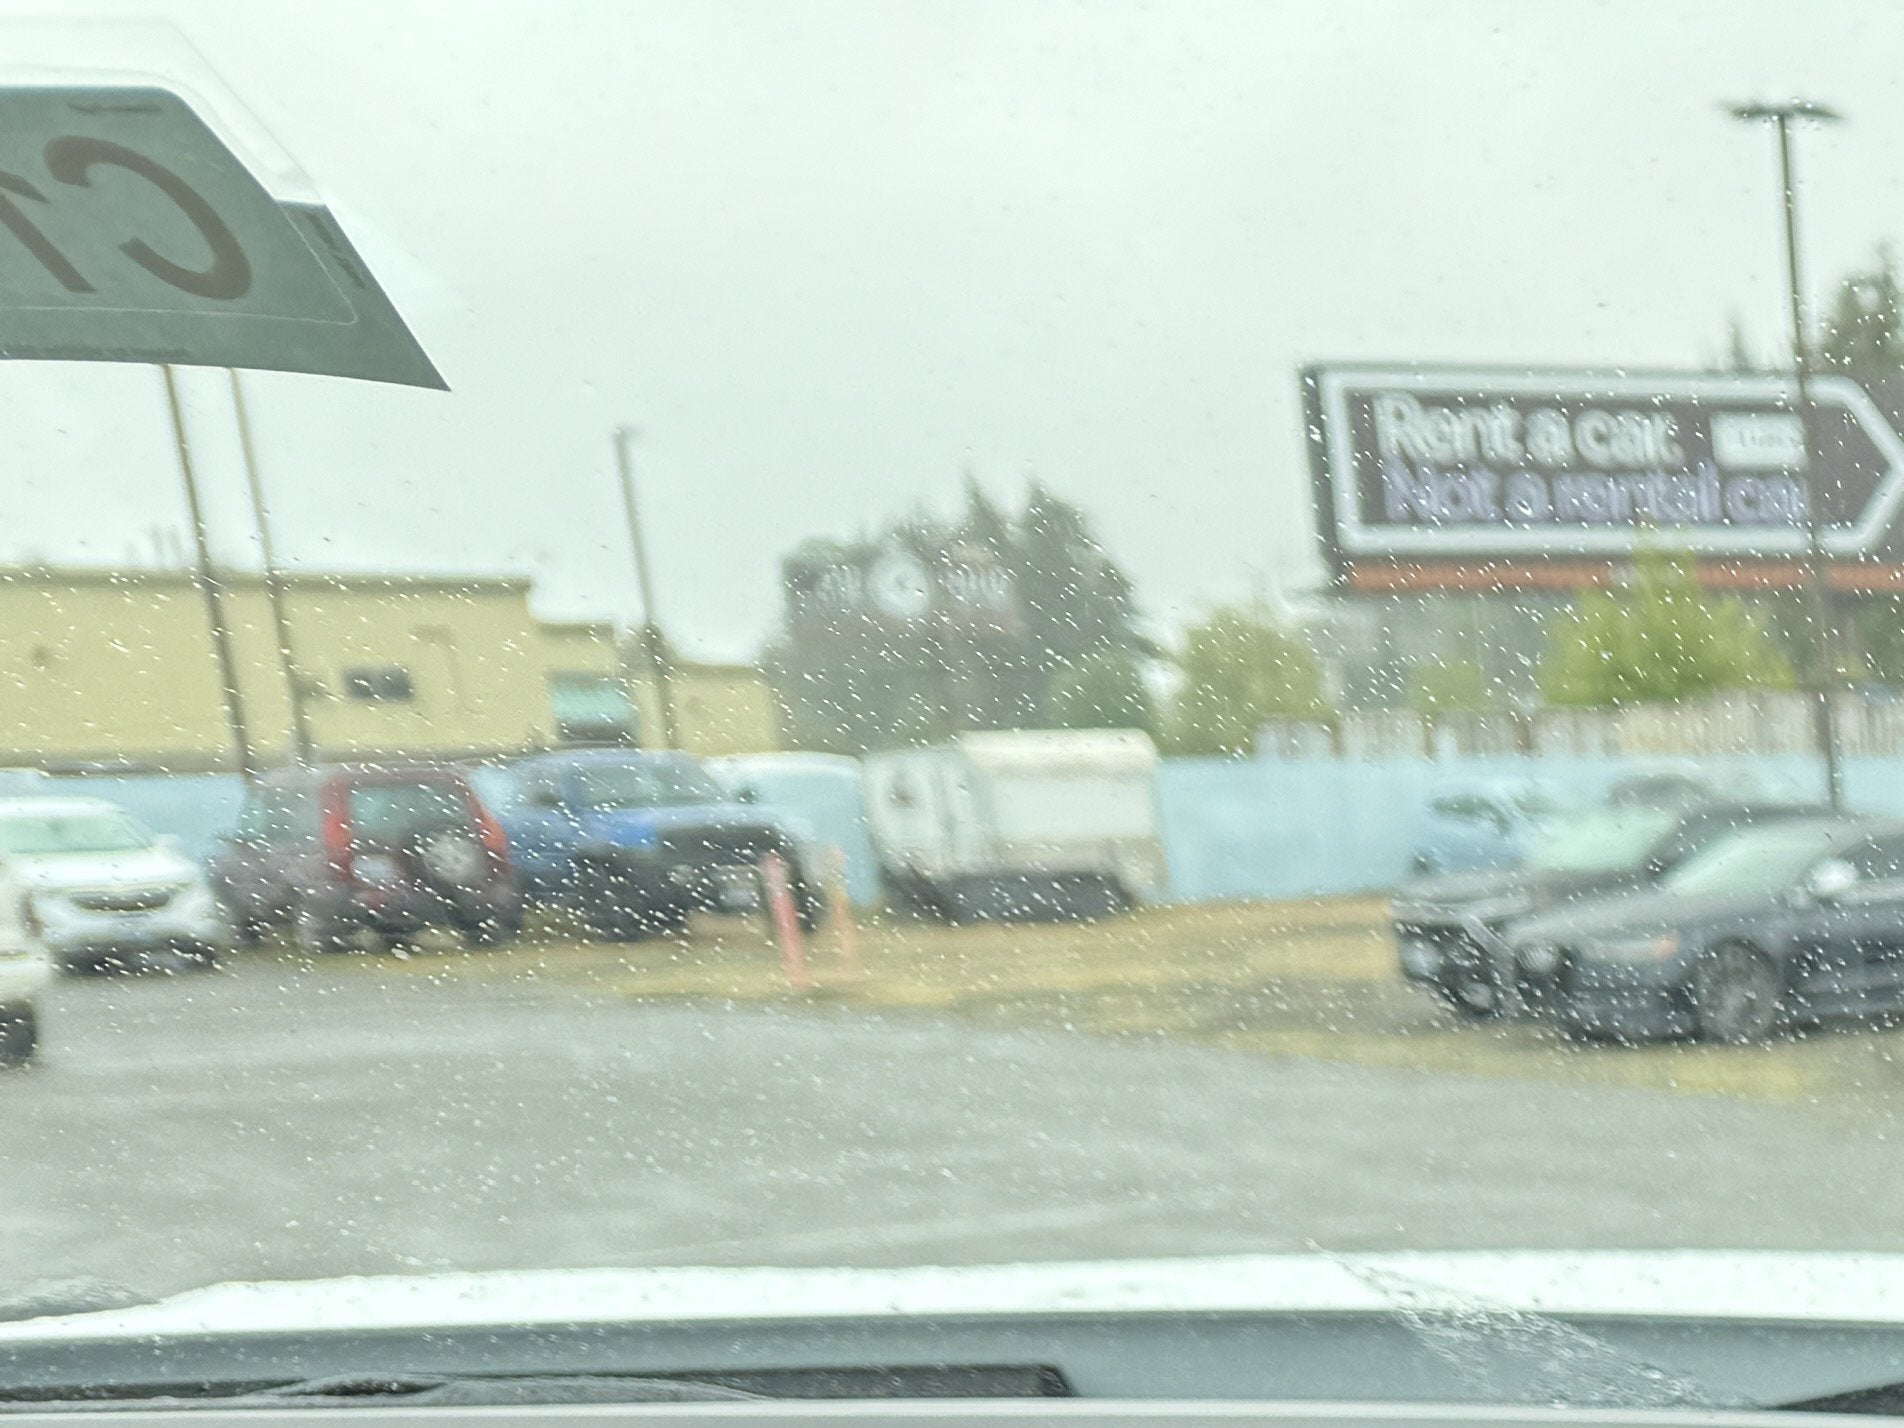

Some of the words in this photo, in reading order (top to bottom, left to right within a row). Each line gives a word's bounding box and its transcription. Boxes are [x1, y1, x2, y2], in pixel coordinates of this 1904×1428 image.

[1374, 390, 1525, 467] Rent
[1525, 408, 1573, 466] a
[1382, 458, 1499, 524] Not
[1504, 470, 1552, 522] a
[1554, 457, 1722, 524] rental
